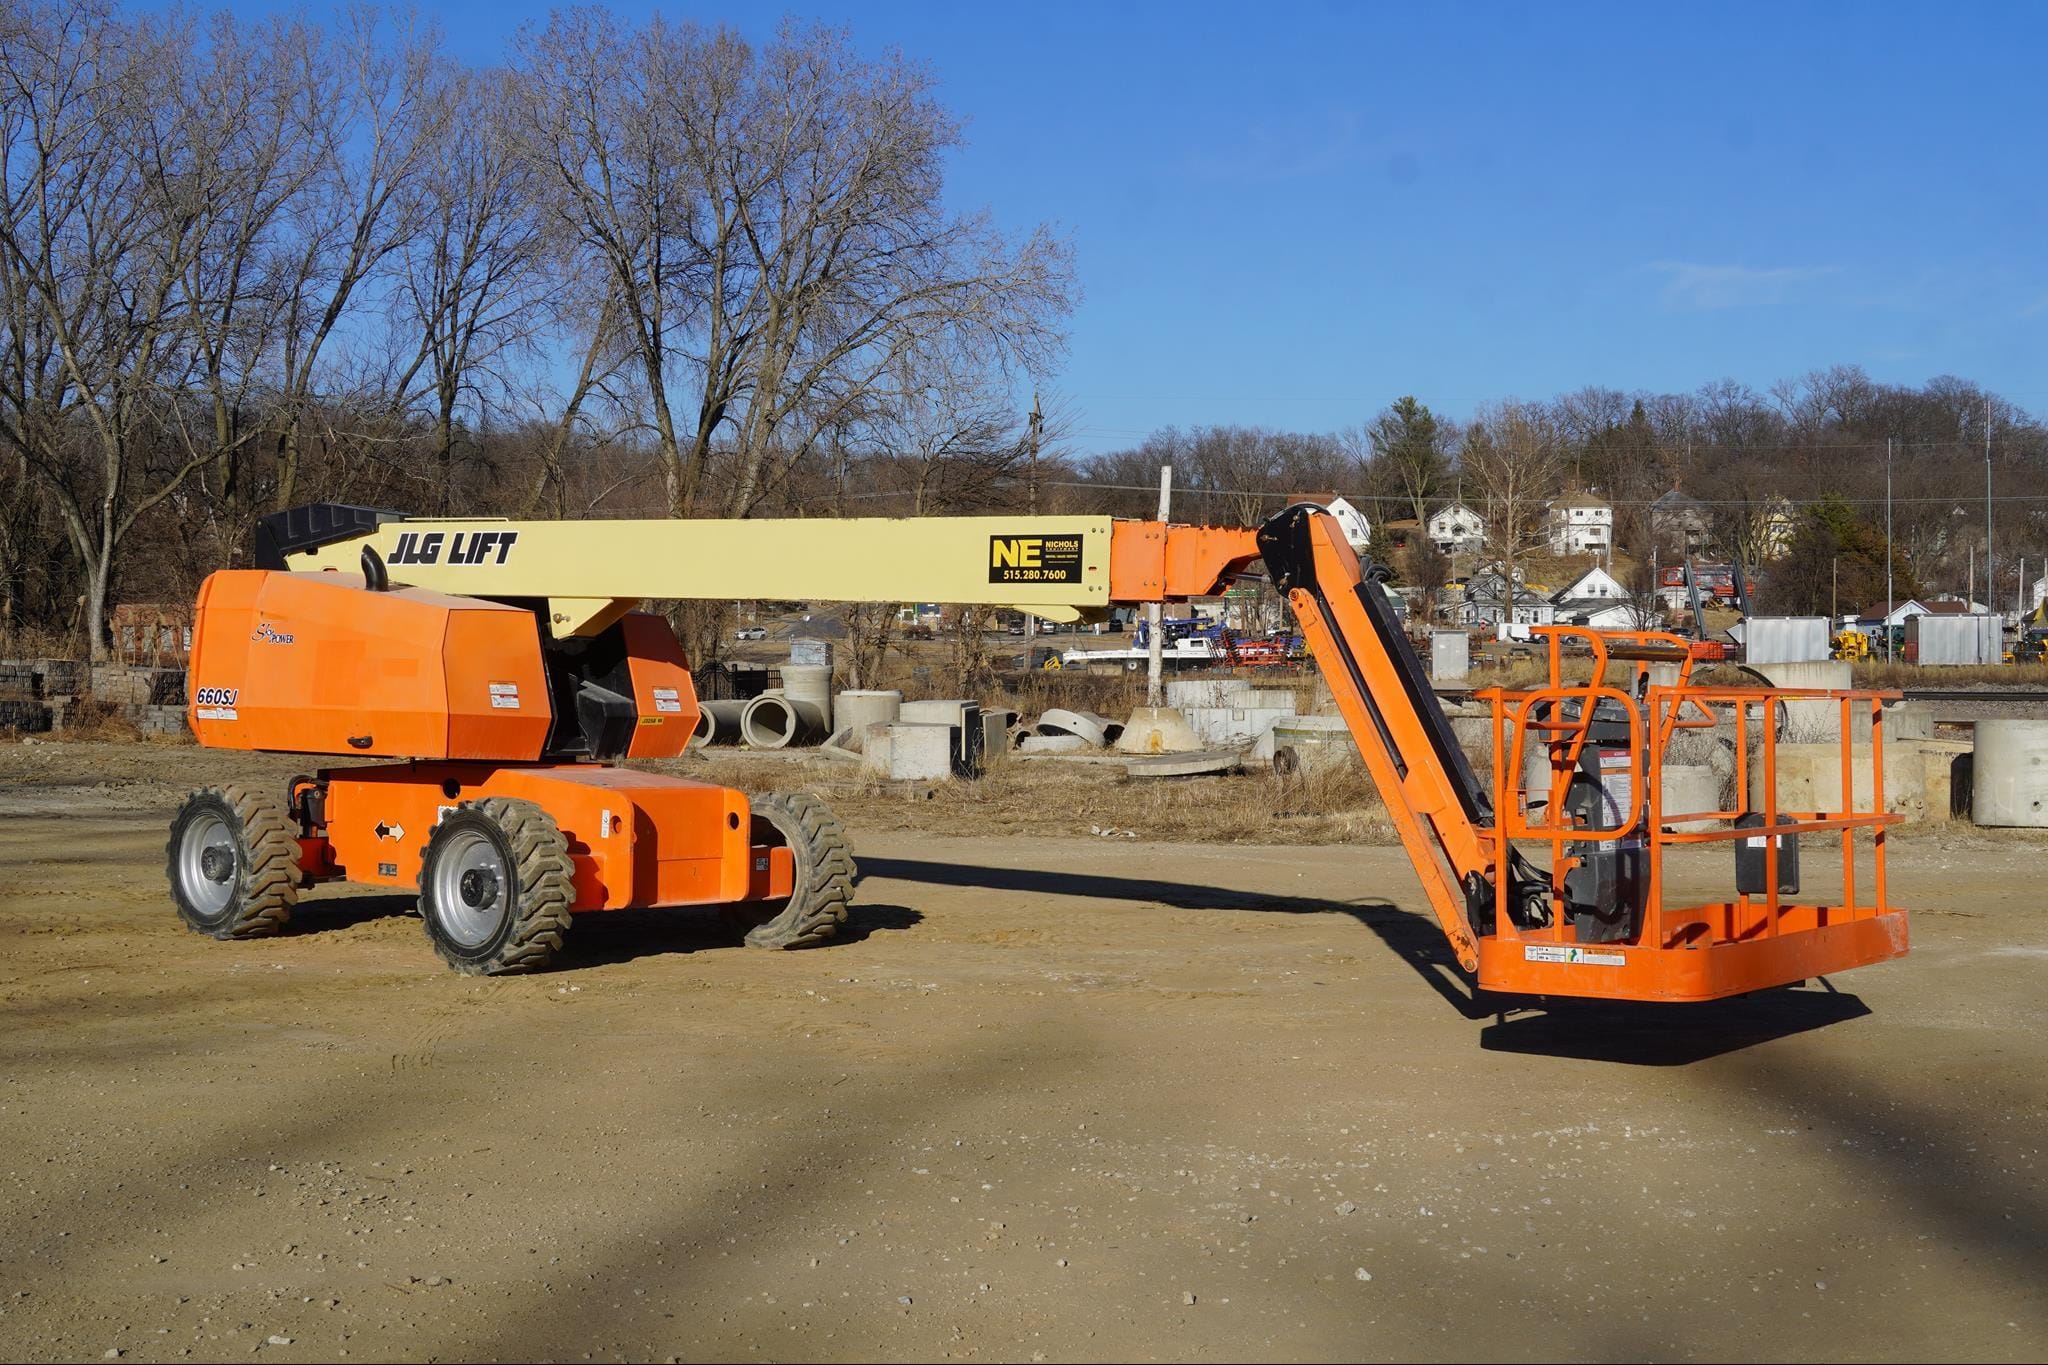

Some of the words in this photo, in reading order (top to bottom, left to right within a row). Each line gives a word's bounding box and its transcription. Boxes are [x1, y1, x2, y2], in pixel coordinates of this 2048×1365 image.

[387, 532, 445, 565] JLG
[447, 531, 518, 565] LIFT
[1045, 540, 1079, 549] NICHOLS
[992, 539, 1043, 568] NE
[1003, 569, 1067, 580] 515.280.7600
[271, 634, 294, 644] POWER
[197, 687, 238, 706] 660SJ
